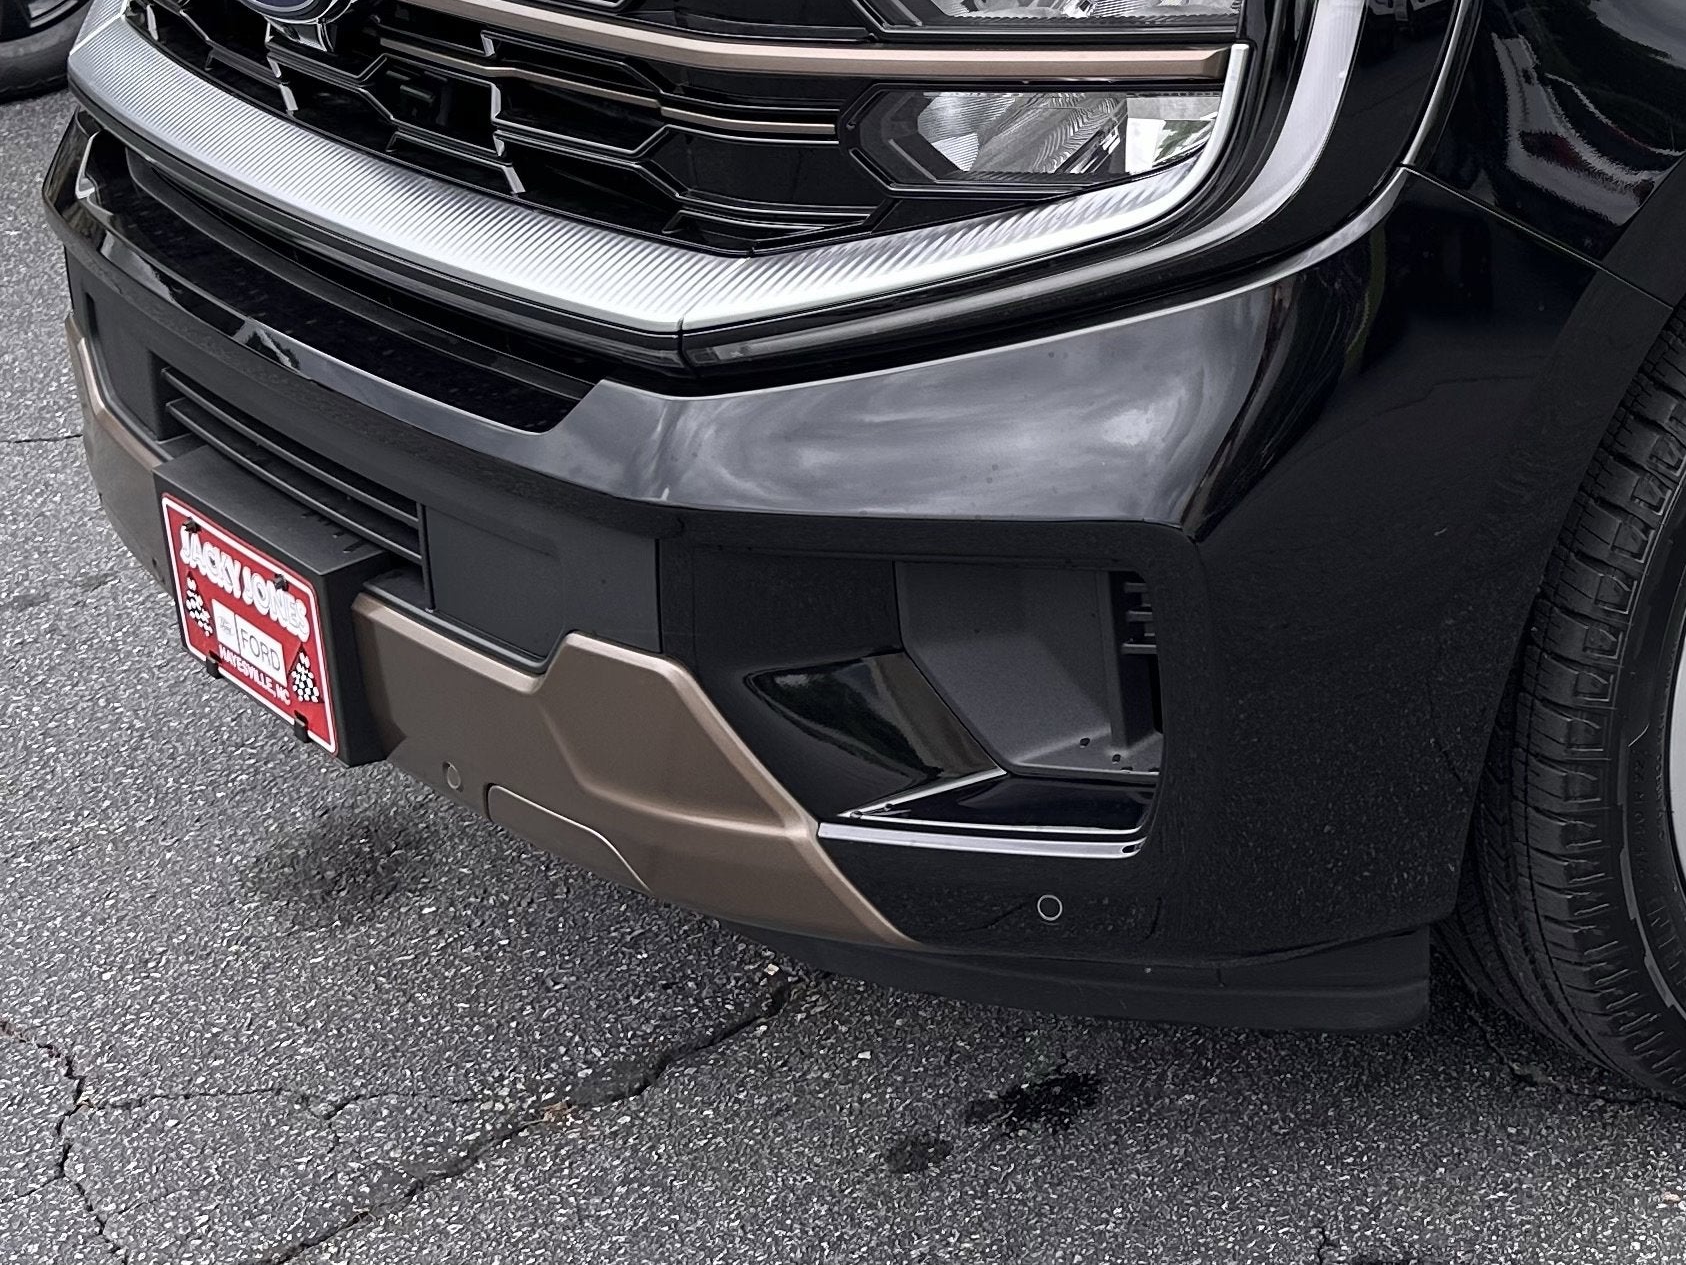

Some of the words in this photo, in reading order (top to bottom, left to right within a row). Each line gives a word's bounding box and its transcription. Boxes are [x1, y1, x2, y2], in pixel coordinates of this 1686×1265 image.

[180, 525, 242, 599] JACKY
[242, 566, 310, 643] JONES
[240, 628, 281, 672] FORD
